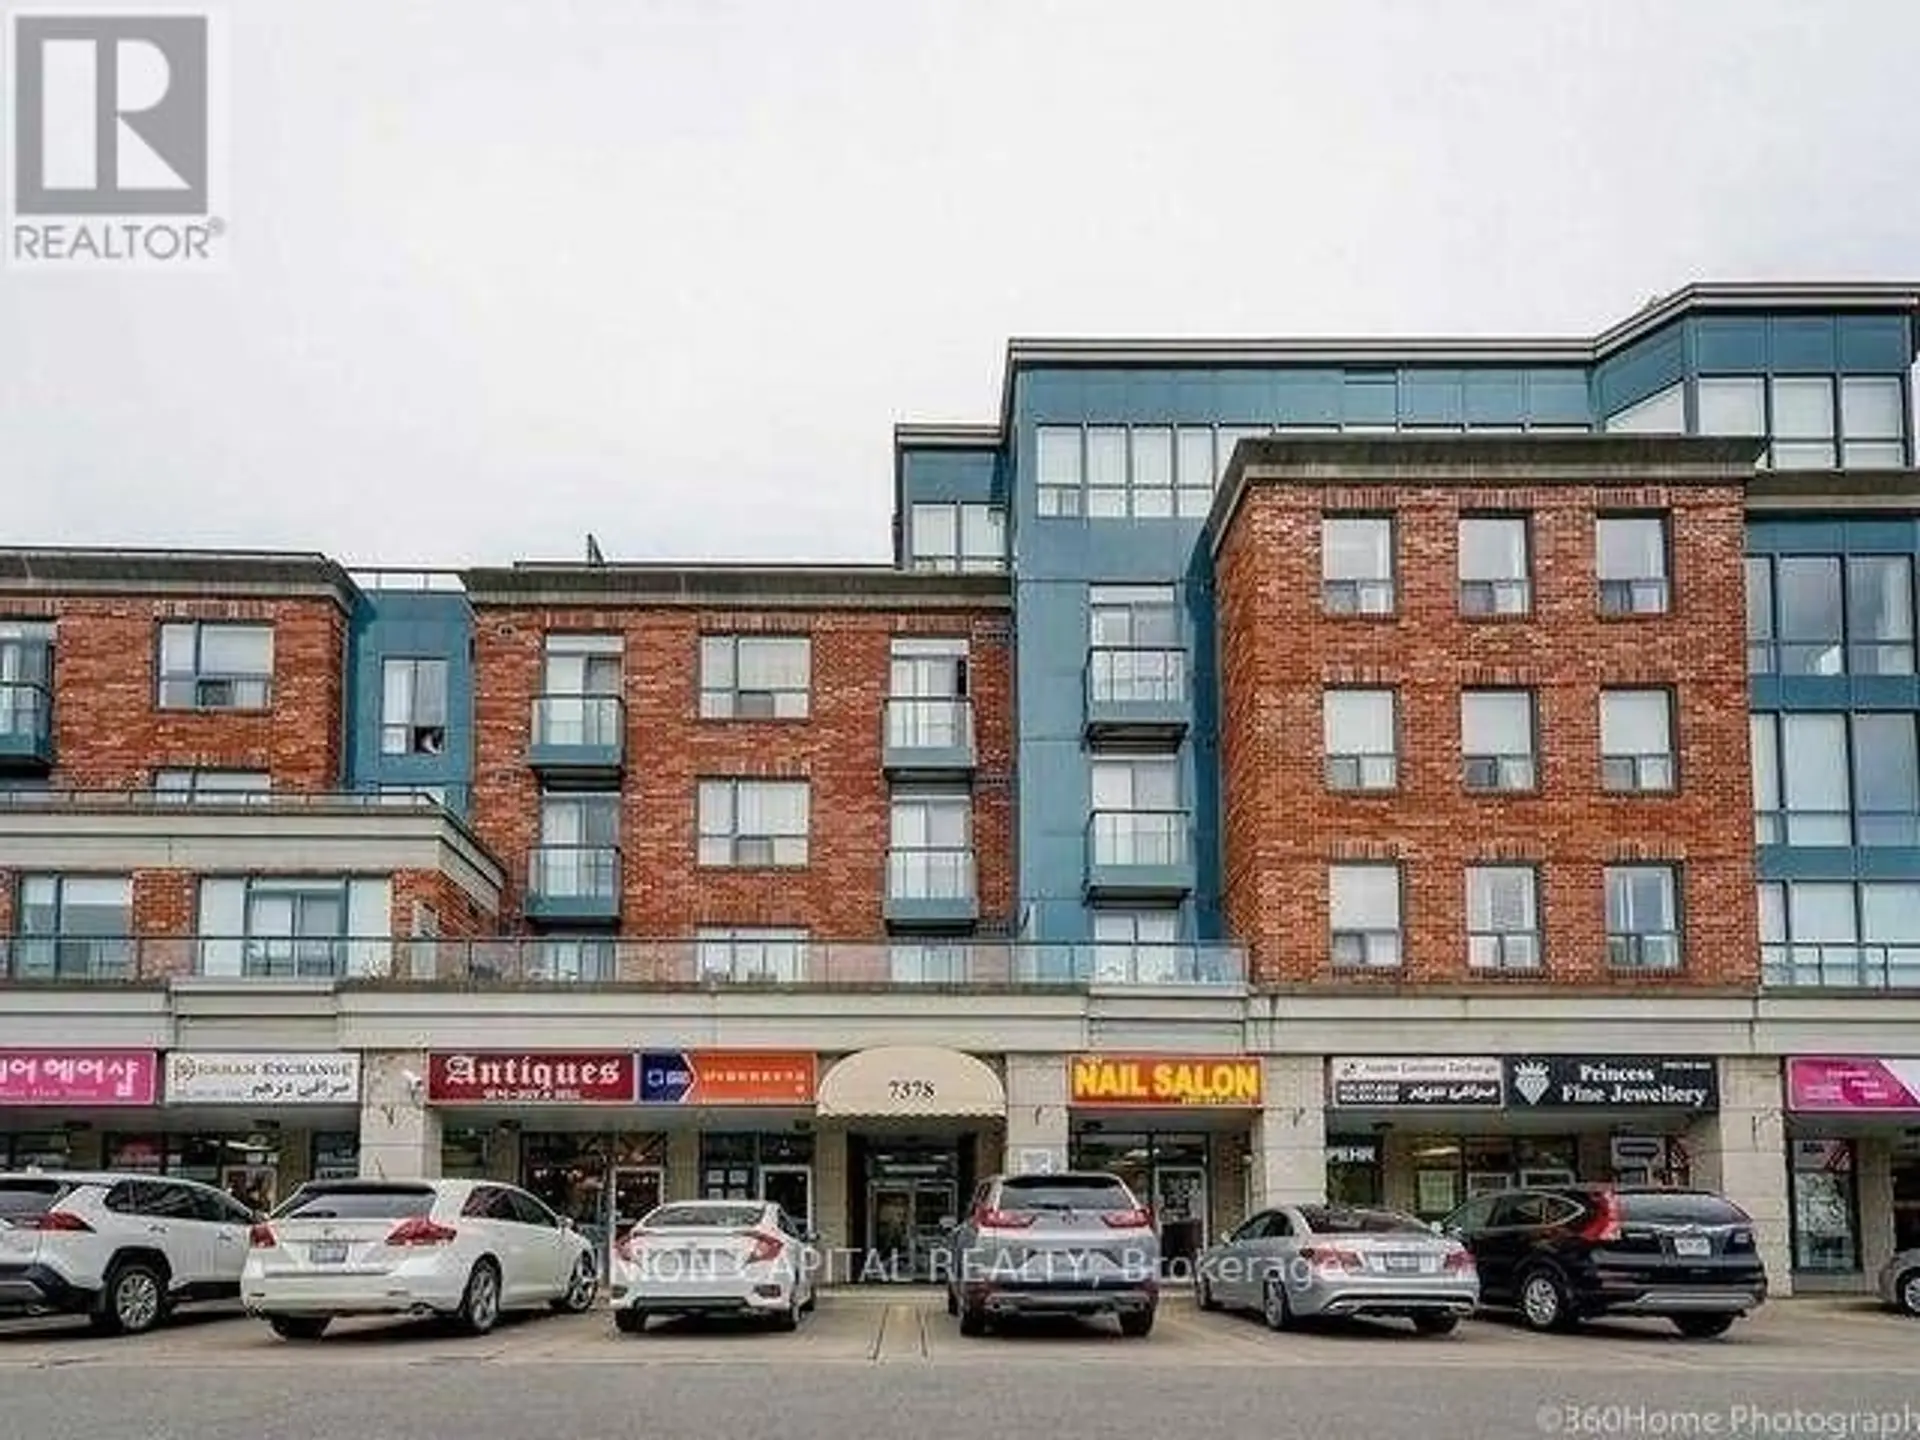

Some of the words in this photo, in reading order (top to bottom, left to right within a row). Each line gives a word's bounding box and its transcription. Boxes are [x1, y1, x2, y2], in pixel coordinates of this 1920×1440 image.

[446, 1055, 620, 1089] Antiques
[1074, 1062, 1148, 1097] NAIL
[1152, 1063, 1258, 1097] SALON
[1580, 1061, 1656, 1082] Princess
[888, 1079, 936, 1099] 7378
[1562, 1084, 1606, 1103] Fine
[1610, 1083, 1708, 1107] Jewellery
